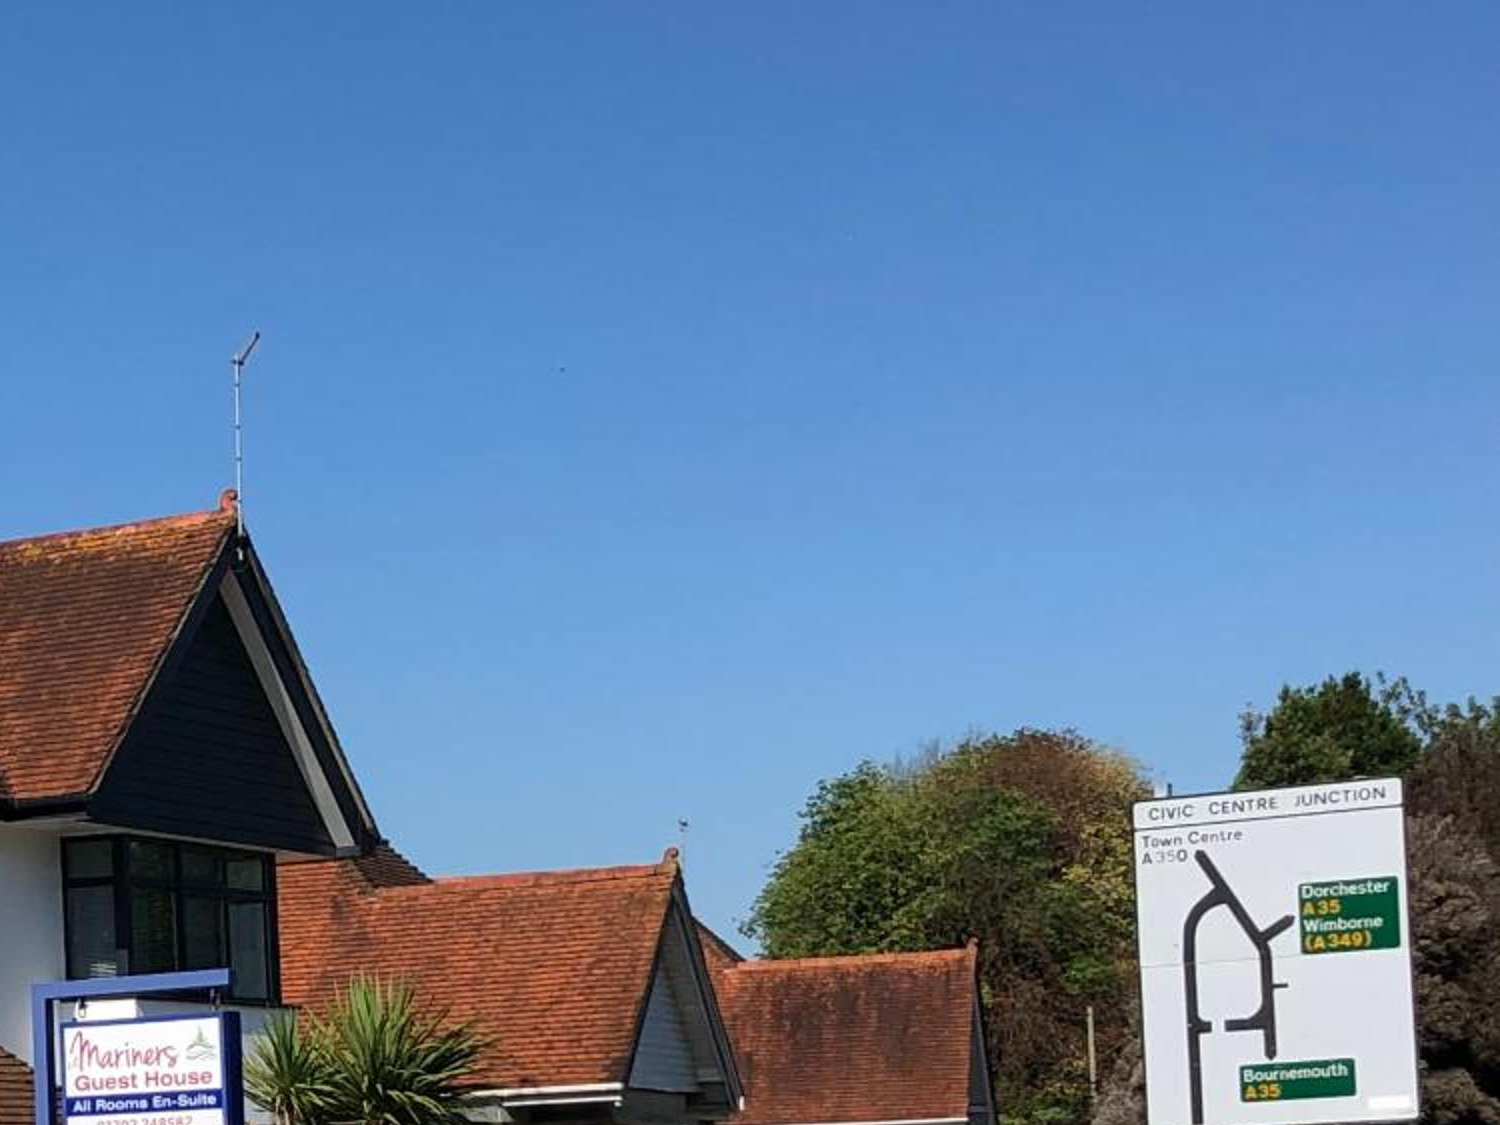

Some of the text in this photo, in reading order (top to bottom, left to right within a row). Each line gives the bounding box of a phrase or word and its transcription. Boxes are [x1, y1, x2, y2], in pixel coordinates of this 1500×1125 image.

[1149, 787, 1387, 821] CIVIC CENTRE JUNCTION
[1141, 829, 1243, 849] Town Centre
[1301, 880, 1390, 899] Dorchester
[1303, 916, 1384, 932] Wimborne
[69, 1030, 178, 1072] Mariners
[74, 1070, 213, 1091] Guest House
[1243, 1063, 1349, 1083] Bournemouth
[73, 1093, 217, 1112] All Rooms En-Suite
